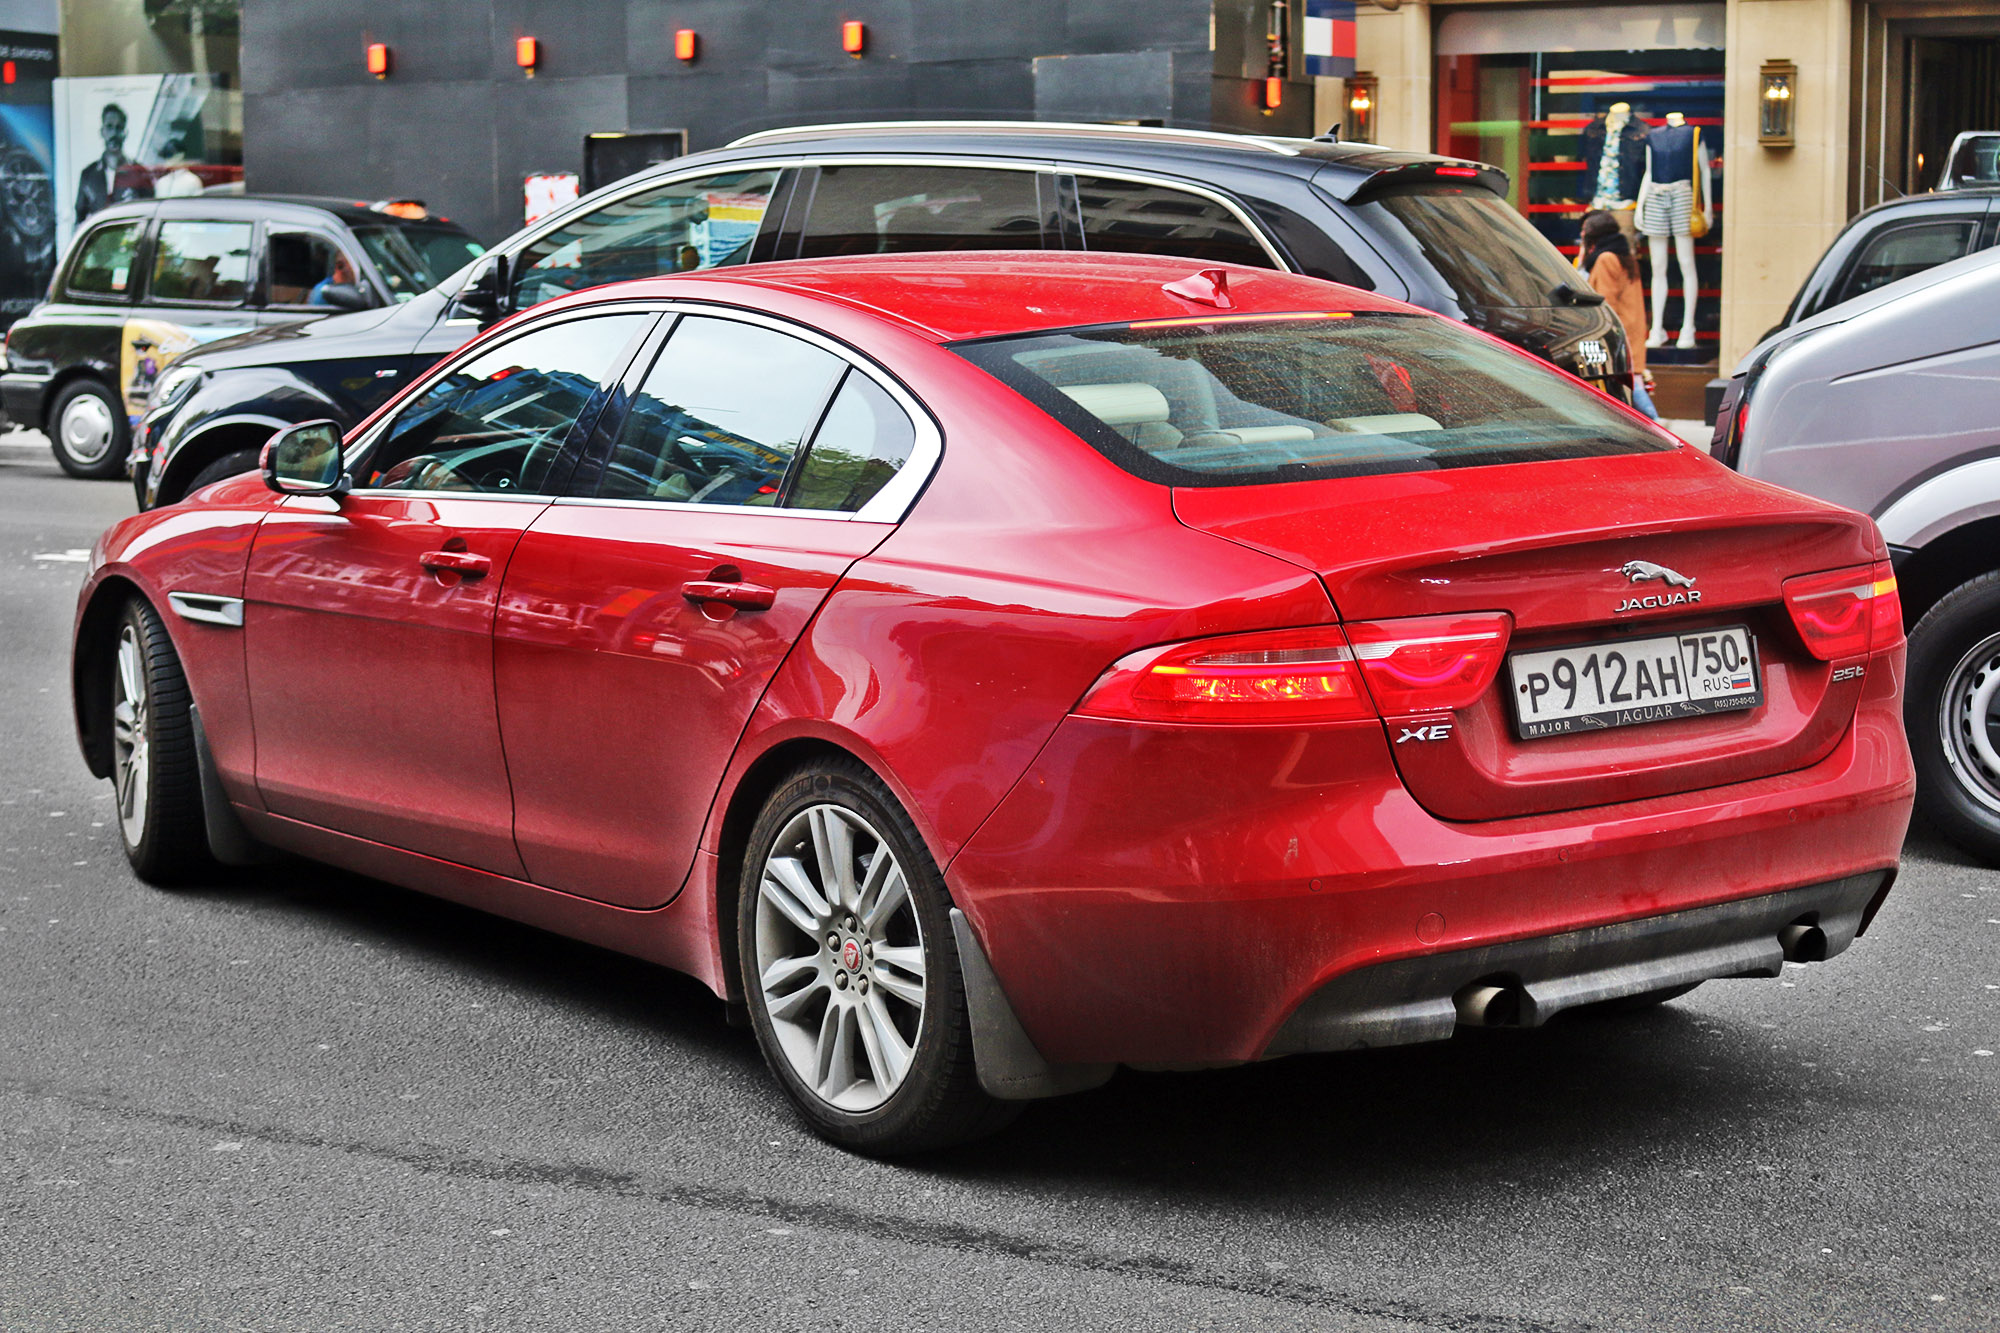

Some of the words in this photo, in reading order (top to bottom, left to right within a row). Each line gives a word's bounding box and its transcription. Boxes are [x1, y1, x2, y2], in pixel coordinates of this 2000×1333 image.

[1614, 590, 1702, 612] JAGUAR
[1527, 651, 1682, 713] P912AH
[1682, 634, 1740, 678] 750
[1703, 676, 1731, 692] RUS
[1529, 720, 1571, 735] MAJOR
[1615, 704, 1673, 726] JAGUAR
[1396, 724, 1453, 743] XE
